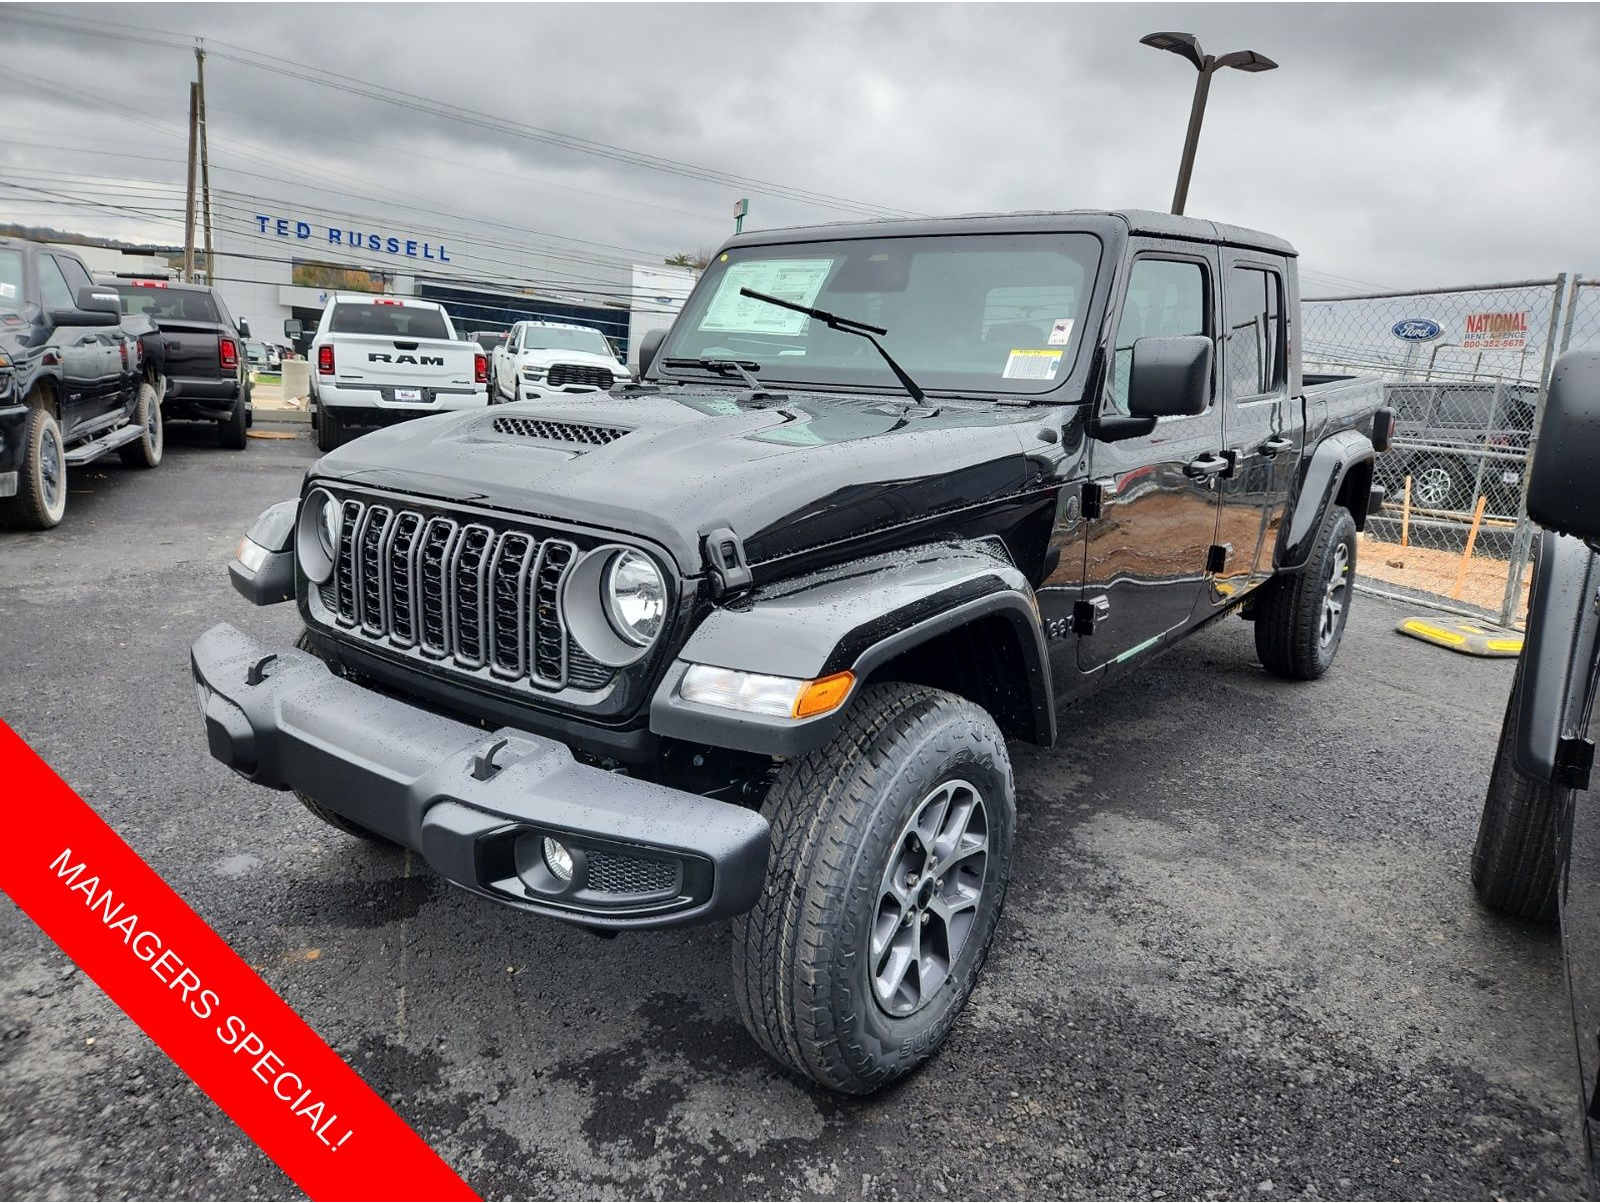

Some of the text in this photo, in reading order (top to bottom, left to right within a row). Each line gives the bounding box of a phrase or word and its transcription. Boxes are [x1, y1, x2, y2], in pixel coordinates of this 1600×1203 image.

[256, 215, 450, 261] TED RUSSELL
[1401, 322, 1432, 338] Ford
[1465, 312, 1527, 333] NATIONAL
[368, 353, 444, 366] RAM
